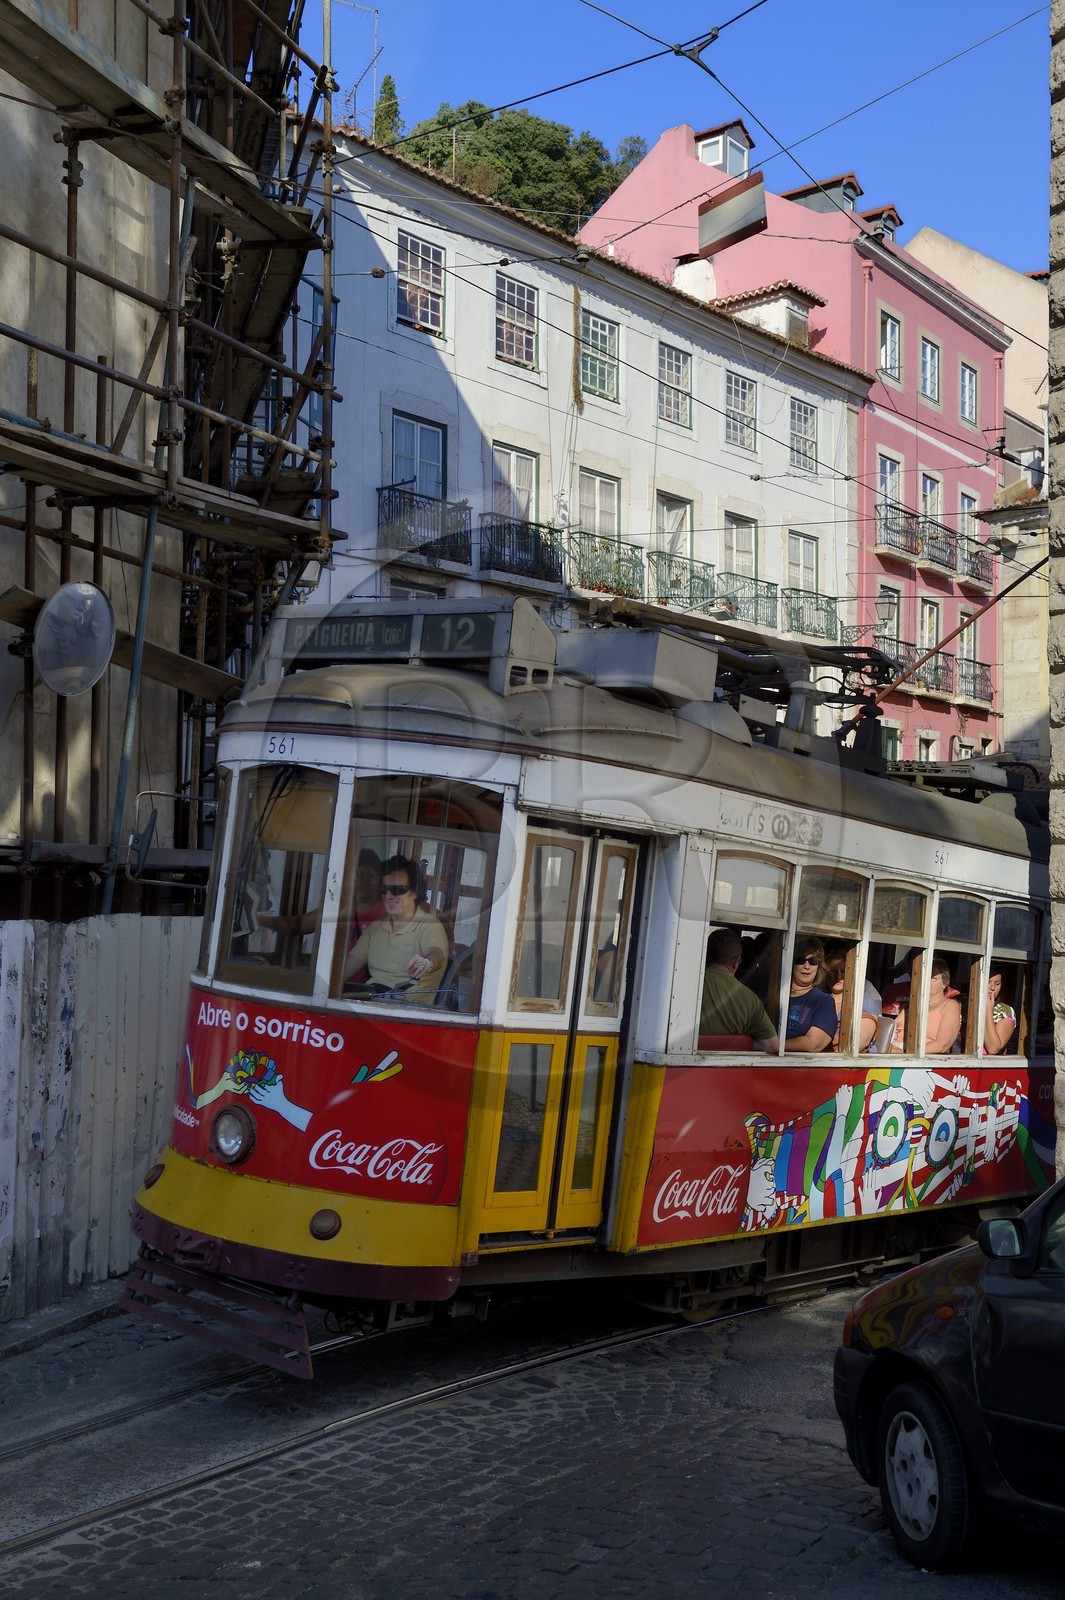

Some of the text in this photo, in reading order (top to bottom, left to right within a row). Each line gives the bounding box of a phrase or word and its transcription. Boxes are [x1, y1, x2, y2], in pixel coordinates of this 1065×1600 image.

[441, 616, 476, 651] 12
[268, 737, 296, 755] 561
[934, 850, 949, 865] 561
[197, 1001, 344, 1052] Abre o sorriso
[308, 1129, 444, 1184] Coca-Cola
[653, 1163, 748, 1223] Coca-Cola
